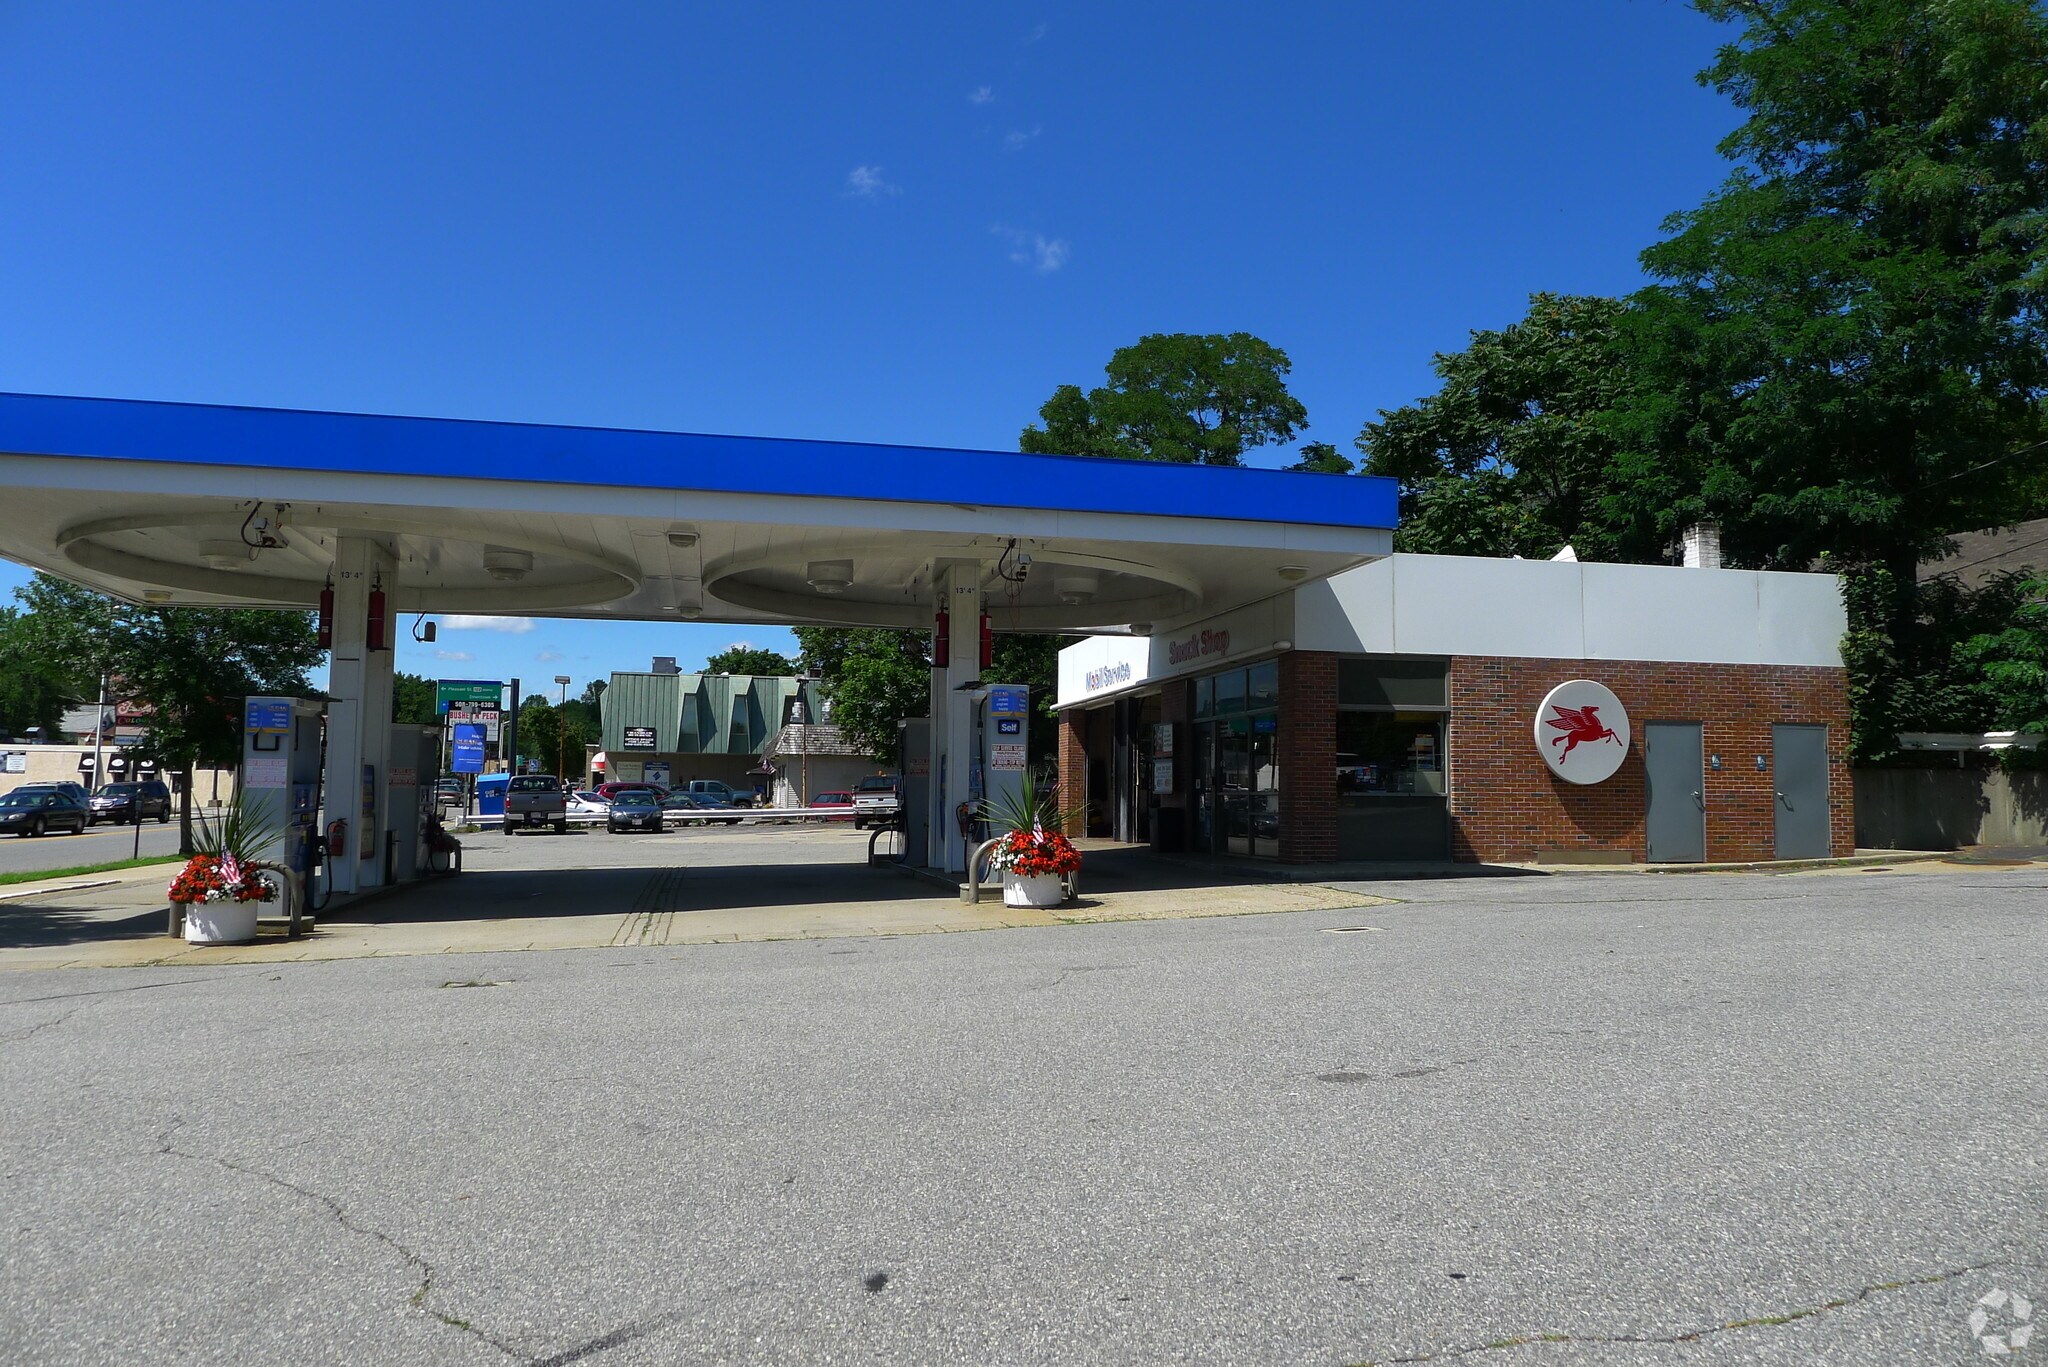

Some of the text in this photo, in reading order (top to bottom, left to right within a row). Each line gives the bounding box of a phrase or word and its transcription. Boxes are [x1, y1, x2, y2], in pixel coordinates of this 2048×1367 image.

[341, 571, 352, 579] 13'
[1169, 629, 1230, 665] Snack Shop
[1085, 660, 1132, 693] Mobil Service
[449, 711, 471, 719] BUSHE
[482, 712, 498, 720] PECK
[1001, 723, 1017, 732] Self
